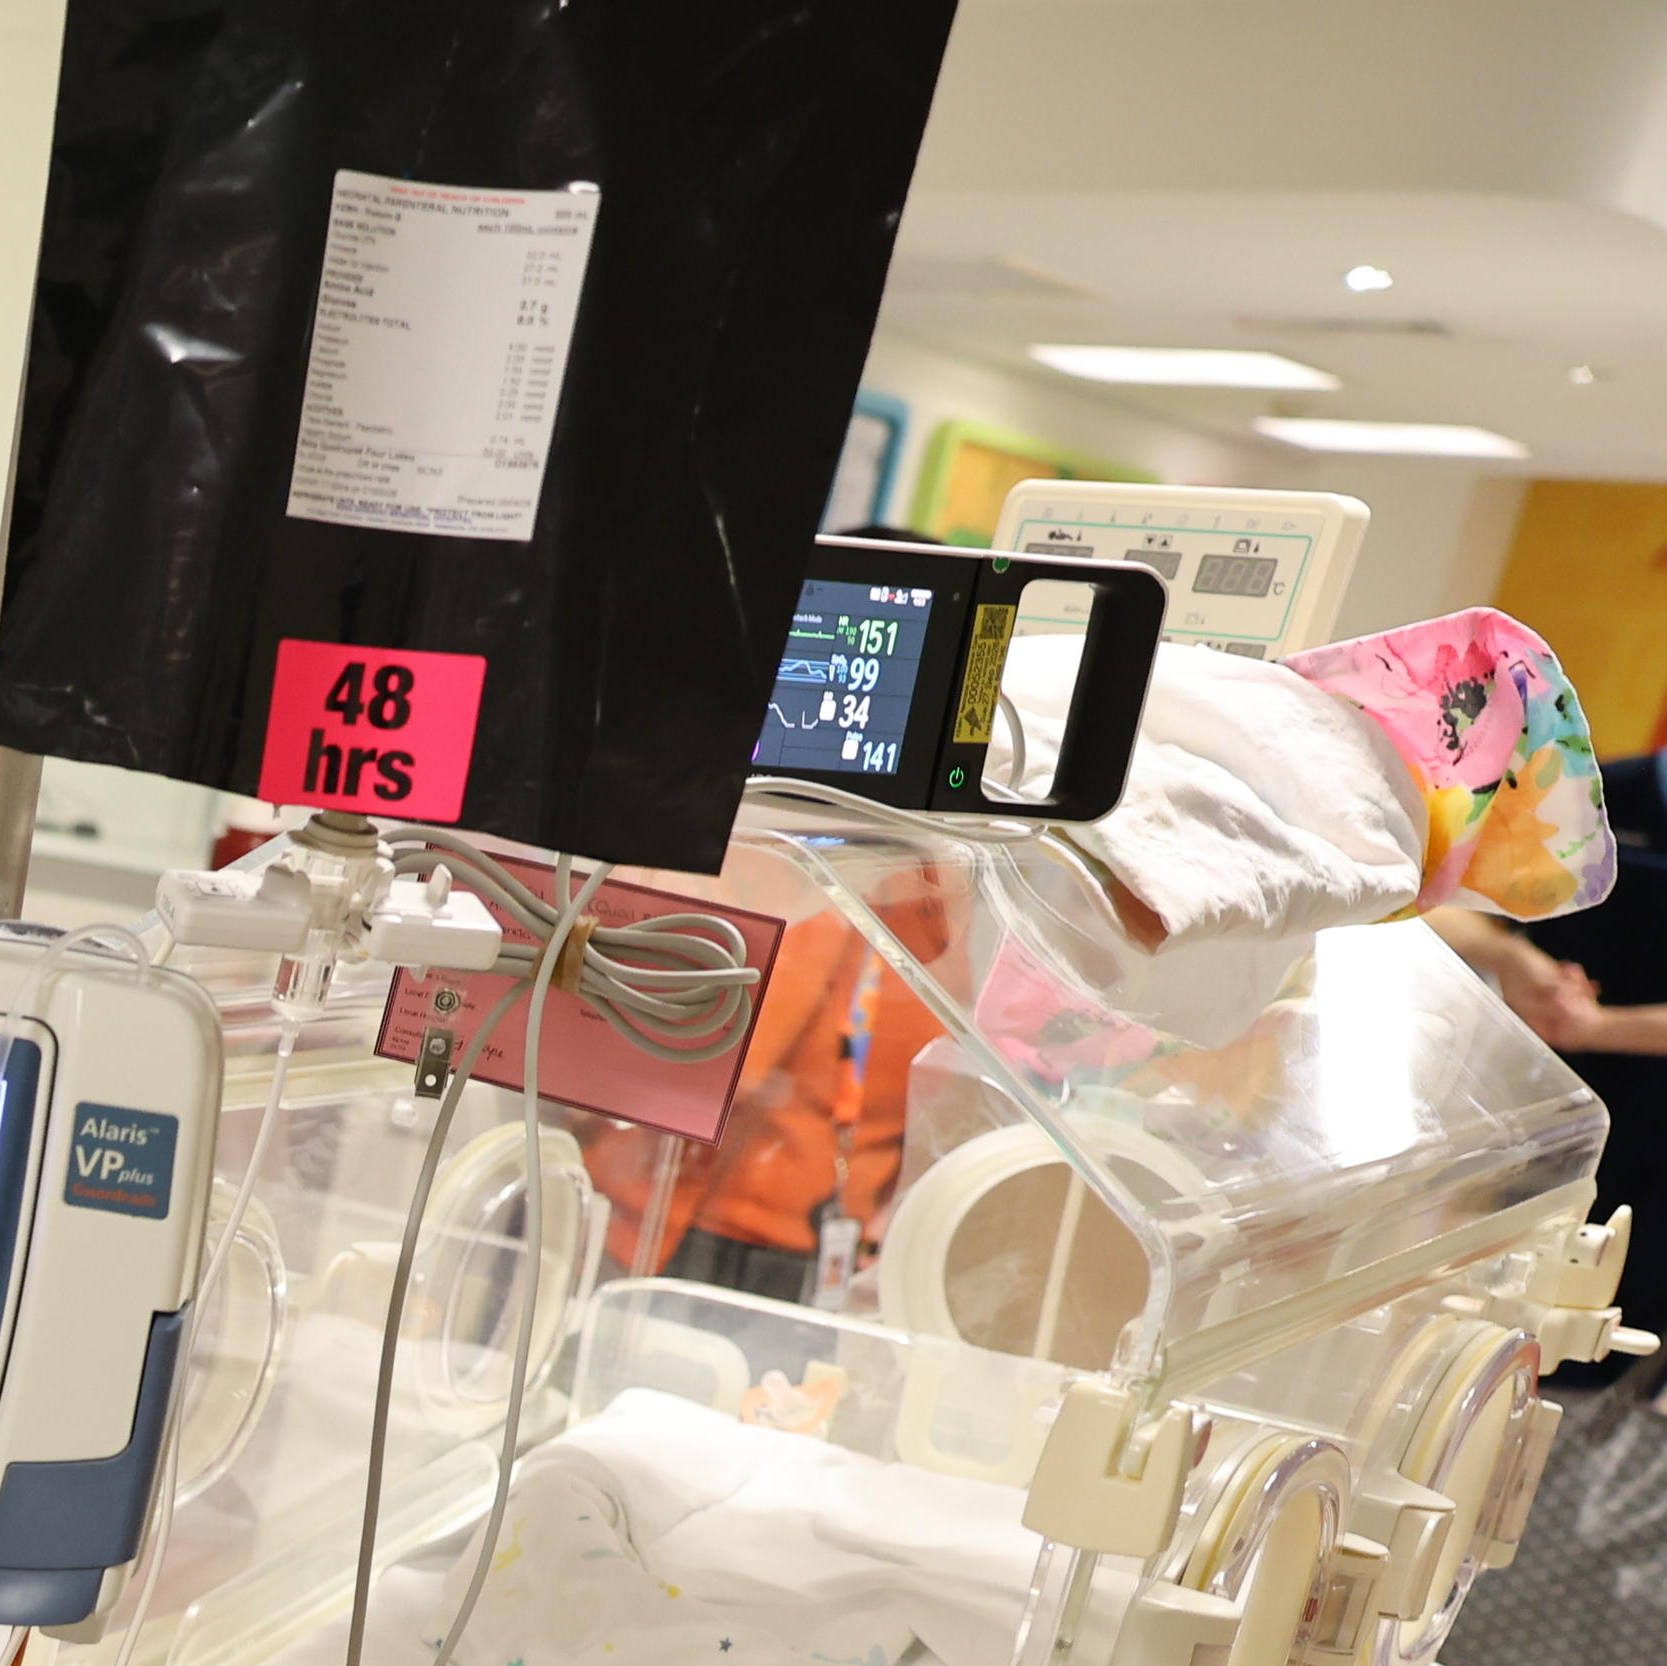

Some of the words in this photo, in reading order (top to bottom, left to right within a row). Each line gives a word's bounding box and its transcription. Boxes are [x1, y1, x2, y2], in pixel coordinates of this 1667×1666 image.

[859, 619, 898, 656] 151
[847, 657, 880, 691] 99
[324, 661, 415, 730] 48
[838, 694, 871, 729] 34
[302, 728, 416, 802] hrs
[862, 741, 897, 773] 141
